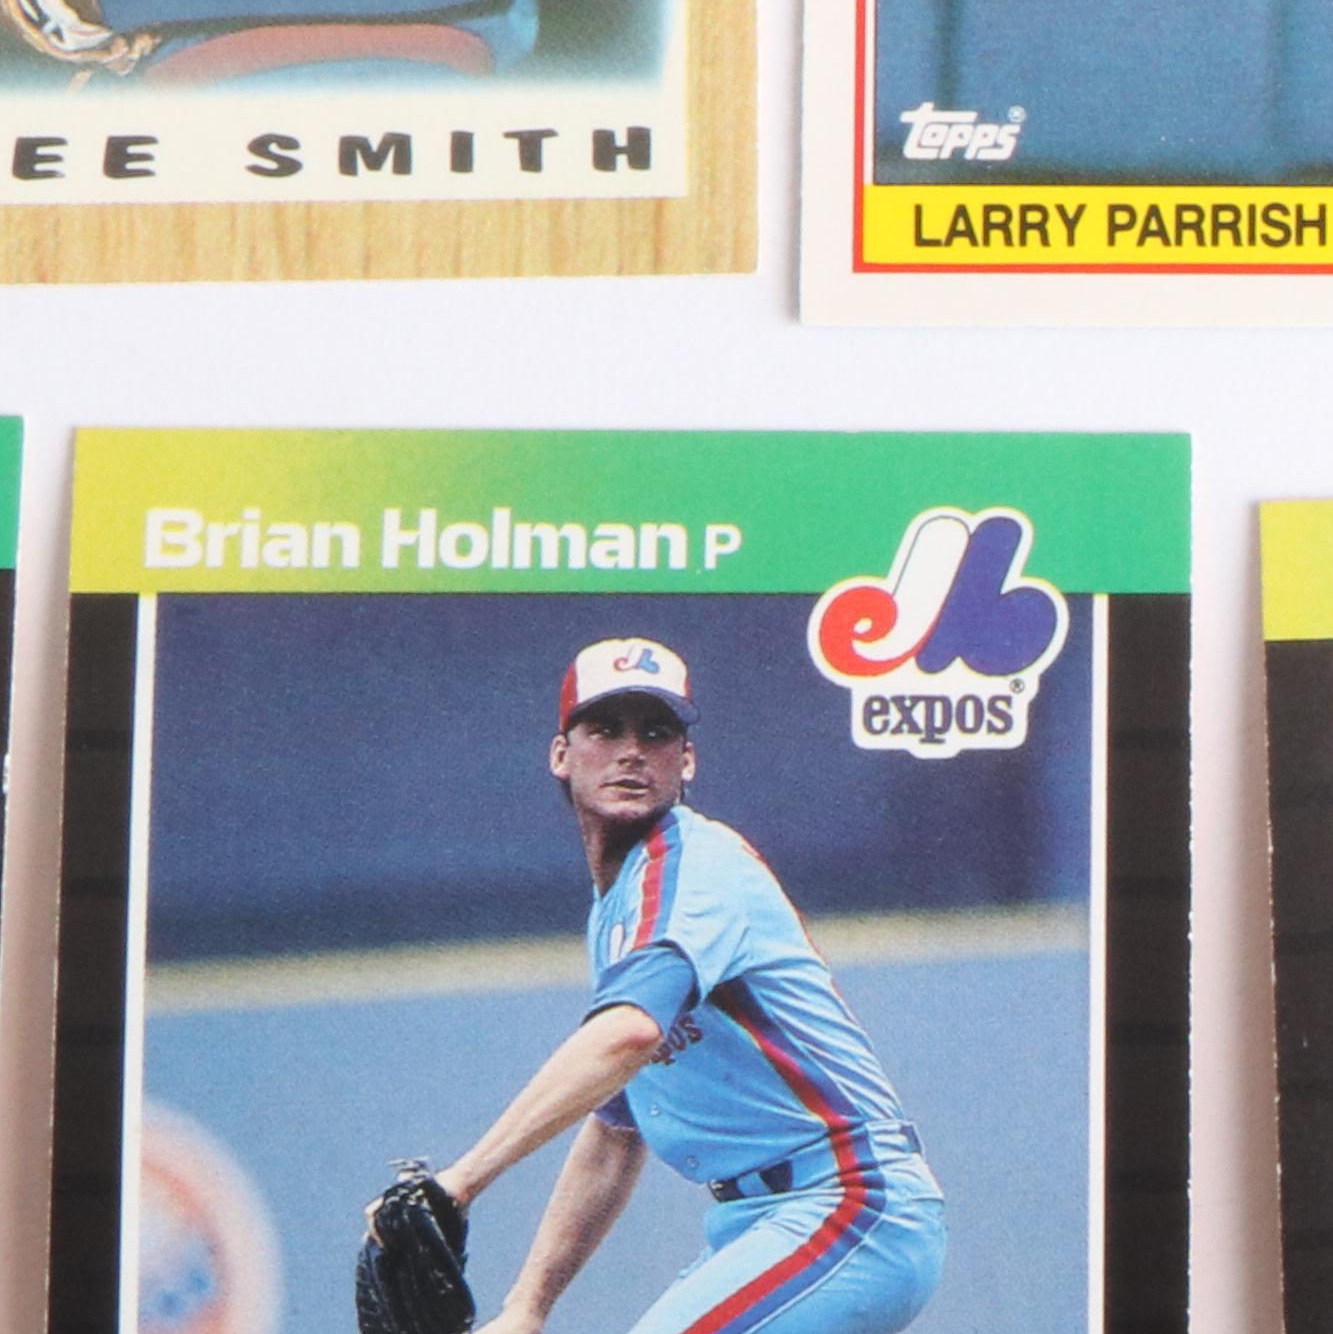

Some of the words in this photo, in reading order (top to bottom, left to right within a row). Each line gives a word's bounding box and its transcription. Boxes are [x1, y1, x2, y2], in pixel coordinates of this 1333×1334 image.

[245, 127, 653, 178] SMITH
[913, 204, 1088, 248] LARRY
[1107, 204, 1328, 249] PARRISH
[143, 507, 361, 569] Brian
[380, 507, 689, 569] Holman
[703, 523, 742, 569] P
[862, 693, 1014, 745] expos
